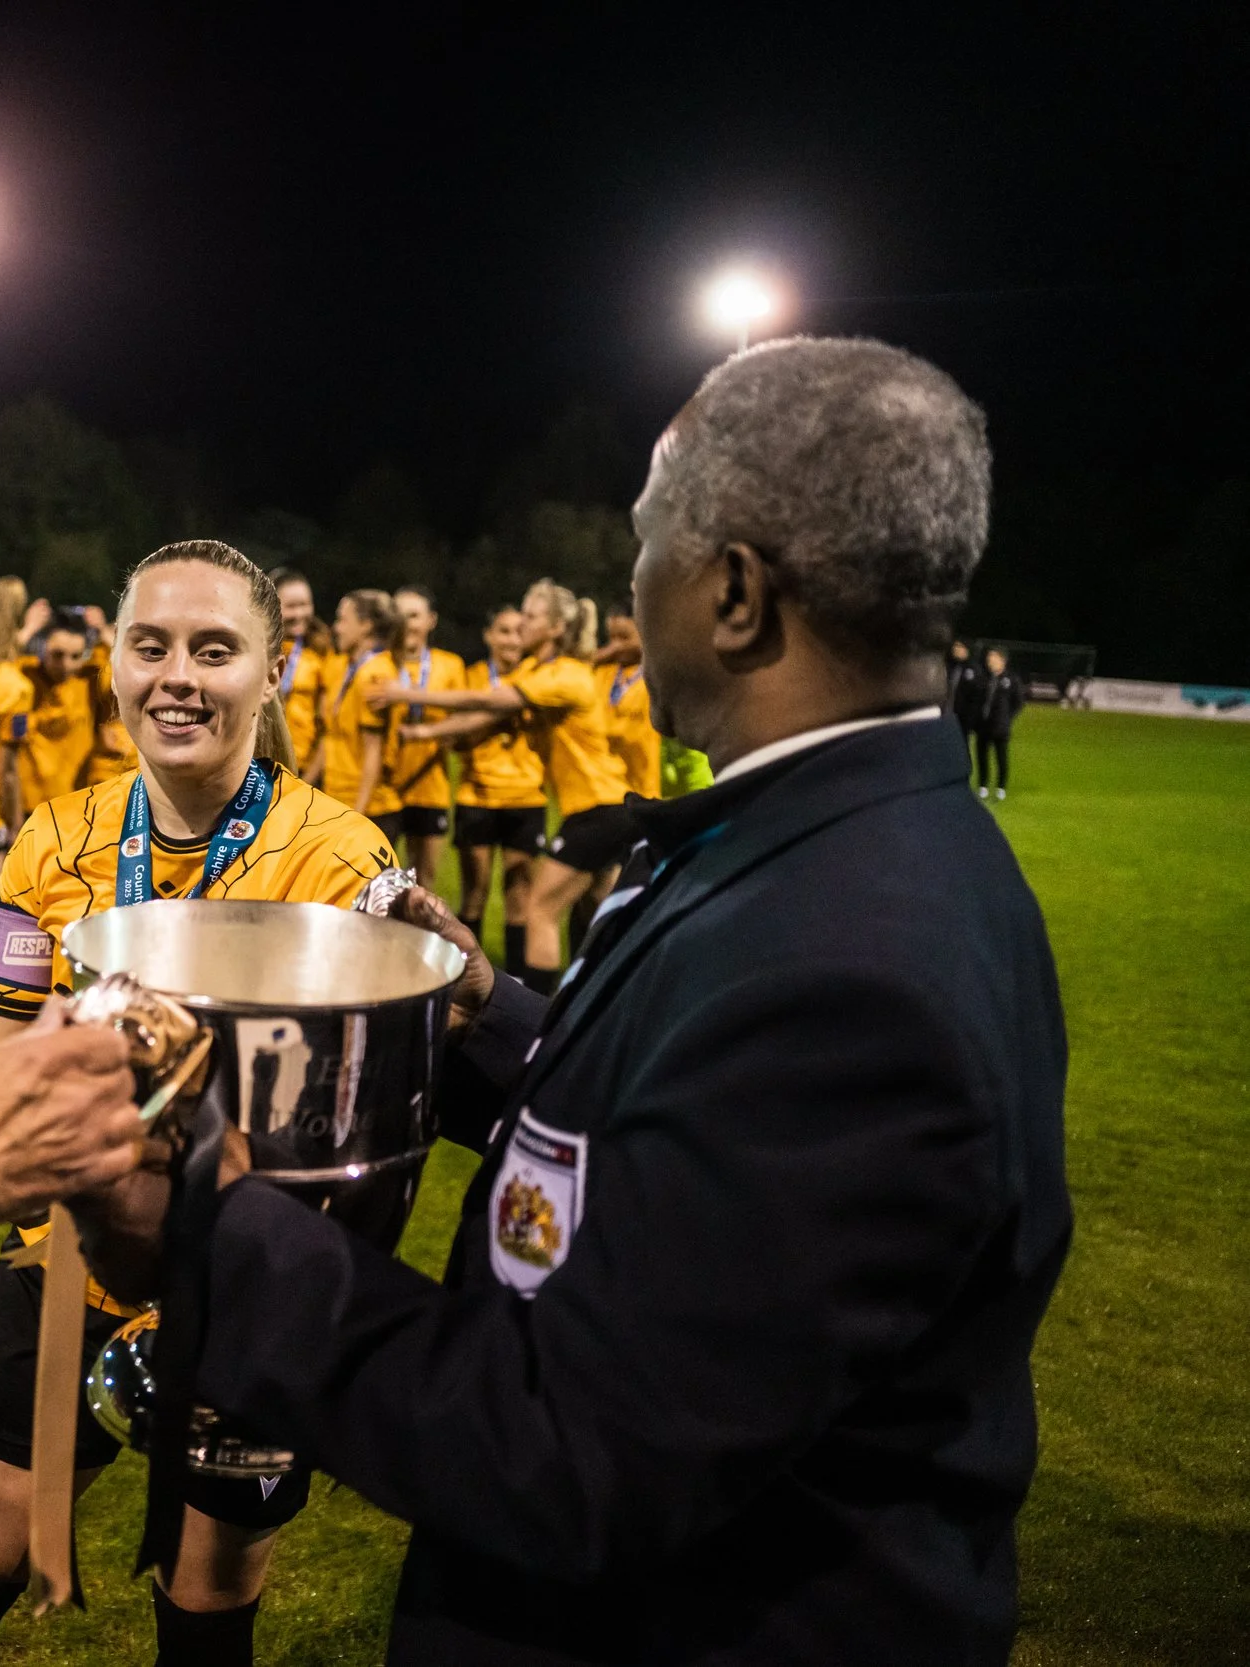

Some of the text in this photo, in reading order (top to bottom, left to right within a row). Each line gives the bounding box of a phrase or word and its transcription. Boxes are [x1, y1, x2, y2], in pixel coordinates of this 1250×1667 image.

[235, 770, 259, 810] County
[254, 783, 265, 801] 2025
[129, 789, 138, 830] Association
[124, 879, 132, 897] 2025
